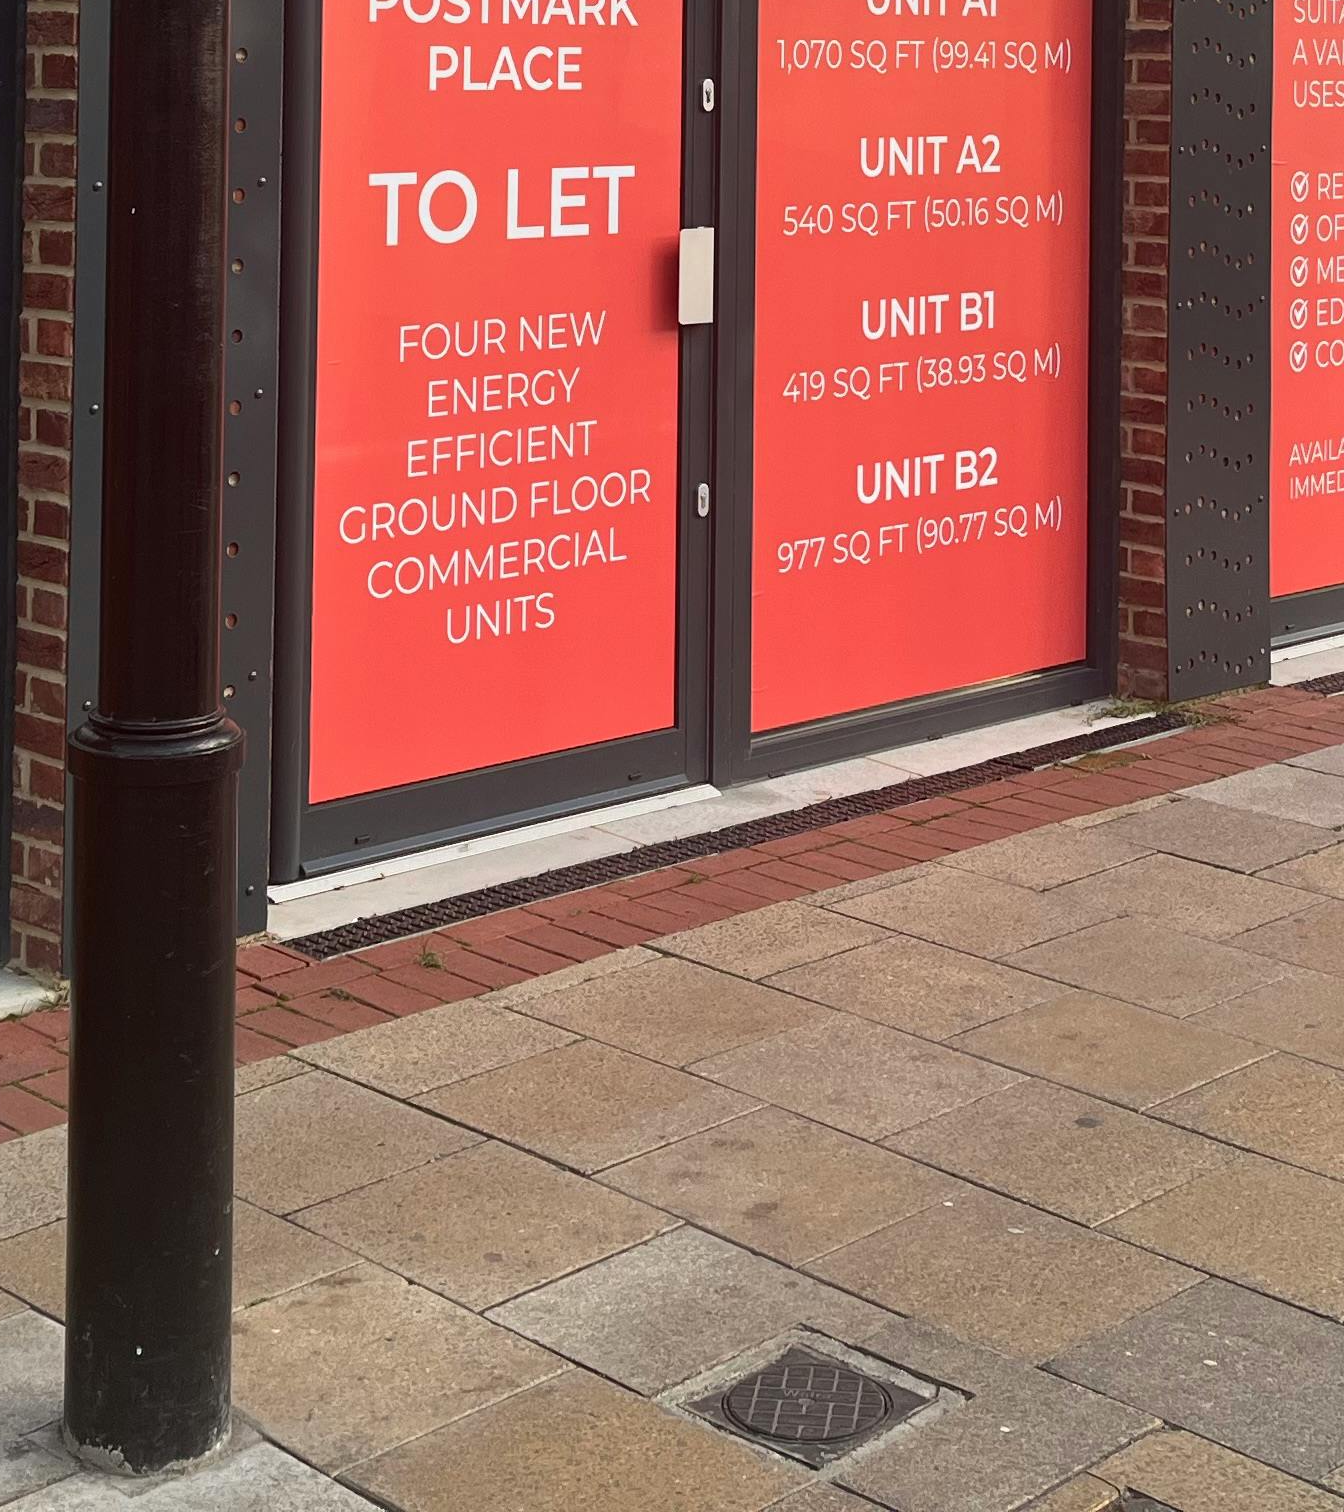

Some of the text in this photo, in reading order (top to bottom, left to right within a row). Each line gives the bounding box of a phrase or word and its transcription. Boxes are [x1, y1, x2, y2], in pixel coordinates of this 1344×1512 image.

[429, 46, 582, 91] PLACE
[777, 37, 1070, 74] 1,070 SQ FT (99.41 SQ M)
[1293, 39, 1308, 65] A
[861, 135, 1000, 177] UNIT A2
[369, 165, 635, 246] TO LET
[783, 191, 1062, 236] 540 SQ FT (50.16 SQ M)
[400, 311, 606, 362] FOUR NEW
[863, 291, 994, 340] UNIT B1
[428, 367, 580, 417] ENERGY
[783, 343, 1060, 402] 419 SQ FT (38.93 SQ M)
[408, 420, 597, 477] EFFICIENT
[857, 447, 998, 504] UNIT B2
[340, 469, 650, 544] GROUND FLOOR
[778, 496, 1061, 573] 977 SQ FT (90.77 SQ M)
[368, 527, 627, 598] COMMERCIAL
[447, 592, 554, 644] UNITS
